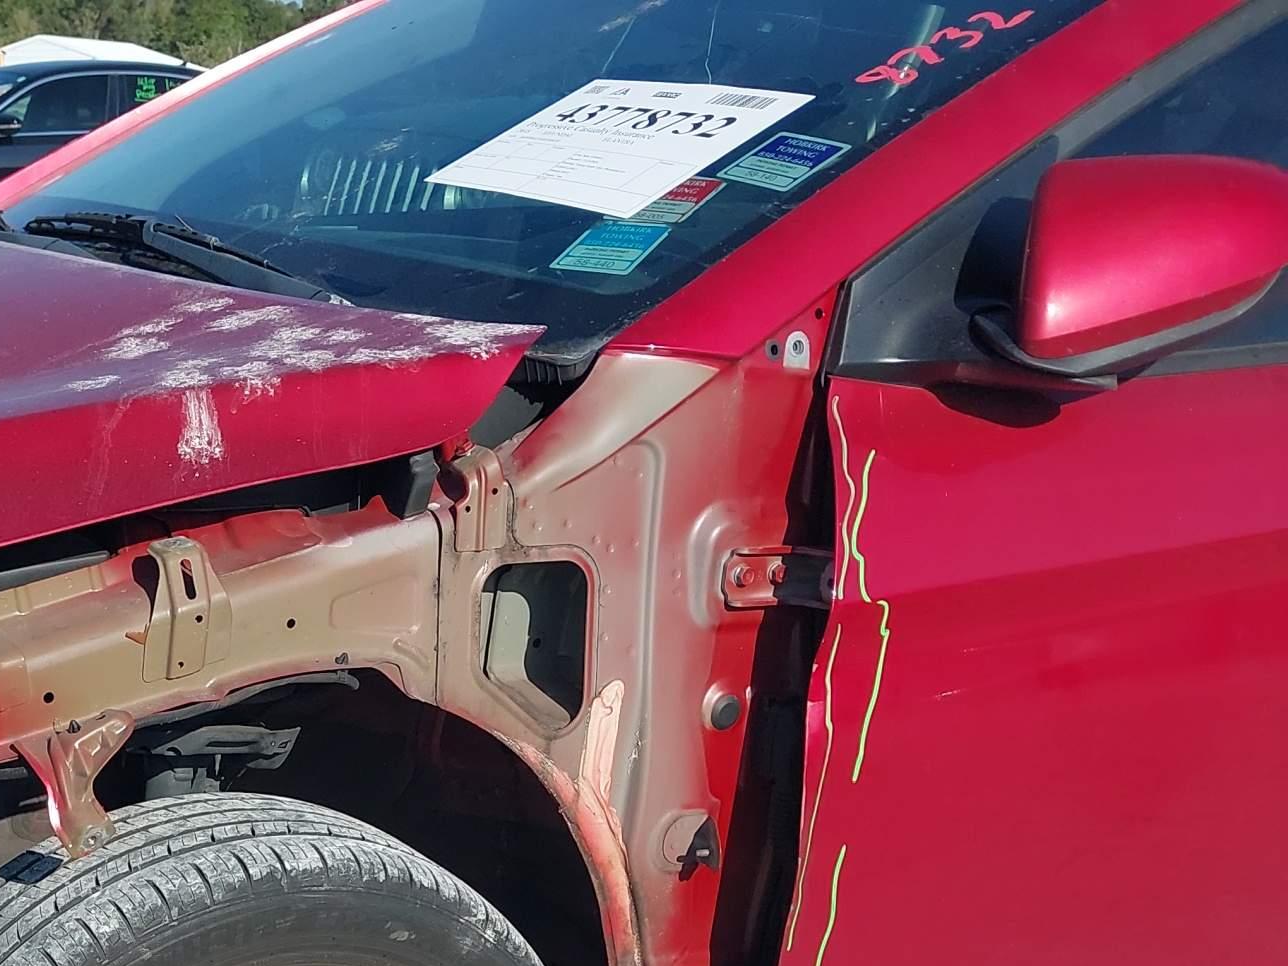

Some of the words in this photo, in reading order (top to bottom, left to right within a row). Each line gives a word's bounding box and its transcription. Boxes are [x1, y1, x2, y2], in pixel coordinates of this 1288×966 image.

[855, 10, 1035, 85] 8732
[557, 103, 737, 138] 43778732
[776, 145, 818, 159] TOWING
[784, 138, 829, 152] HOBKIRK
[600, 232, 645, 241] TOWING
